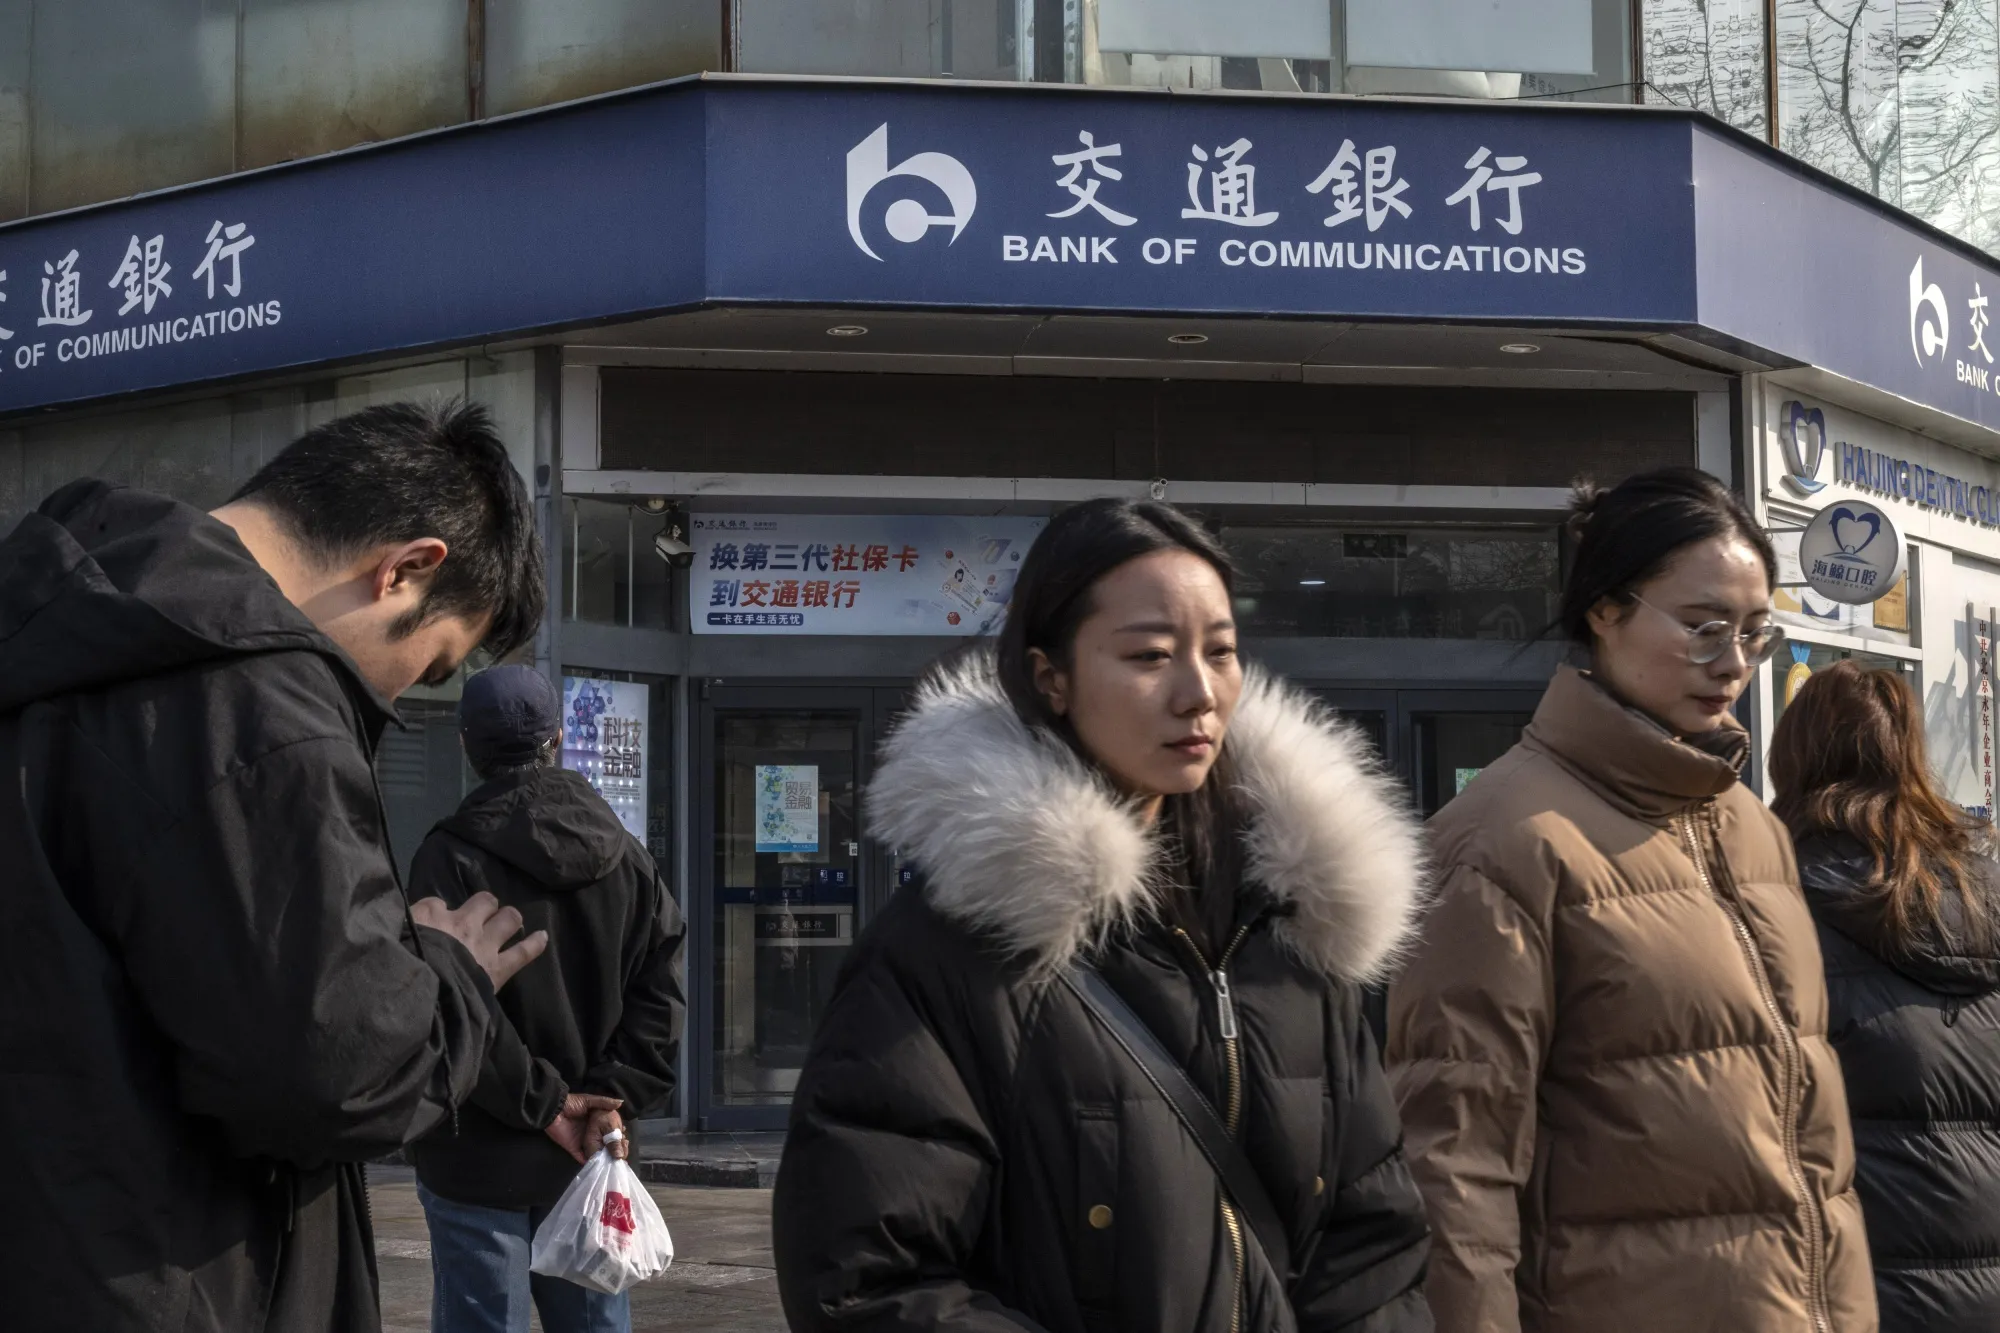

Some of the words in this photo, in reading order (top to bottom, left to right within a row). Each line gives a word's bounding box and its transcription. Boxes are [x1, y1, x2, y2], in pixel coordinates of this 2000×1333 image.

[1045, 130, 1543, 235] 交通銀行
[1001, 234, 1118, 265] BANK
[1141, 237, 1197, 265] OF
[1218, 239, 1587, 275] COMMUNICATIONS
[14, 342, 46, 370] OF
[57, 299, 282, 362] COMMUNICATIONS
[1967, 281, 1994, 364] 交
[1956, 359, 1990, 392] BANK
[1841, 441, 1911, 498] HAIJING
[1915, 463, 1975, 517] DENTAL
[709, 542, 920, 573] 换第三代社保卡
[709, 578, 861, 609] 到交通银行
[710, 614, 801, 625] 一卡在手生活无忧
[603, 716, 643, 749] 科技
[602, 748, 642, 779] 金融
[784, 796, 813, 810] 金融
[785, 781, 812, 796] 贸易
